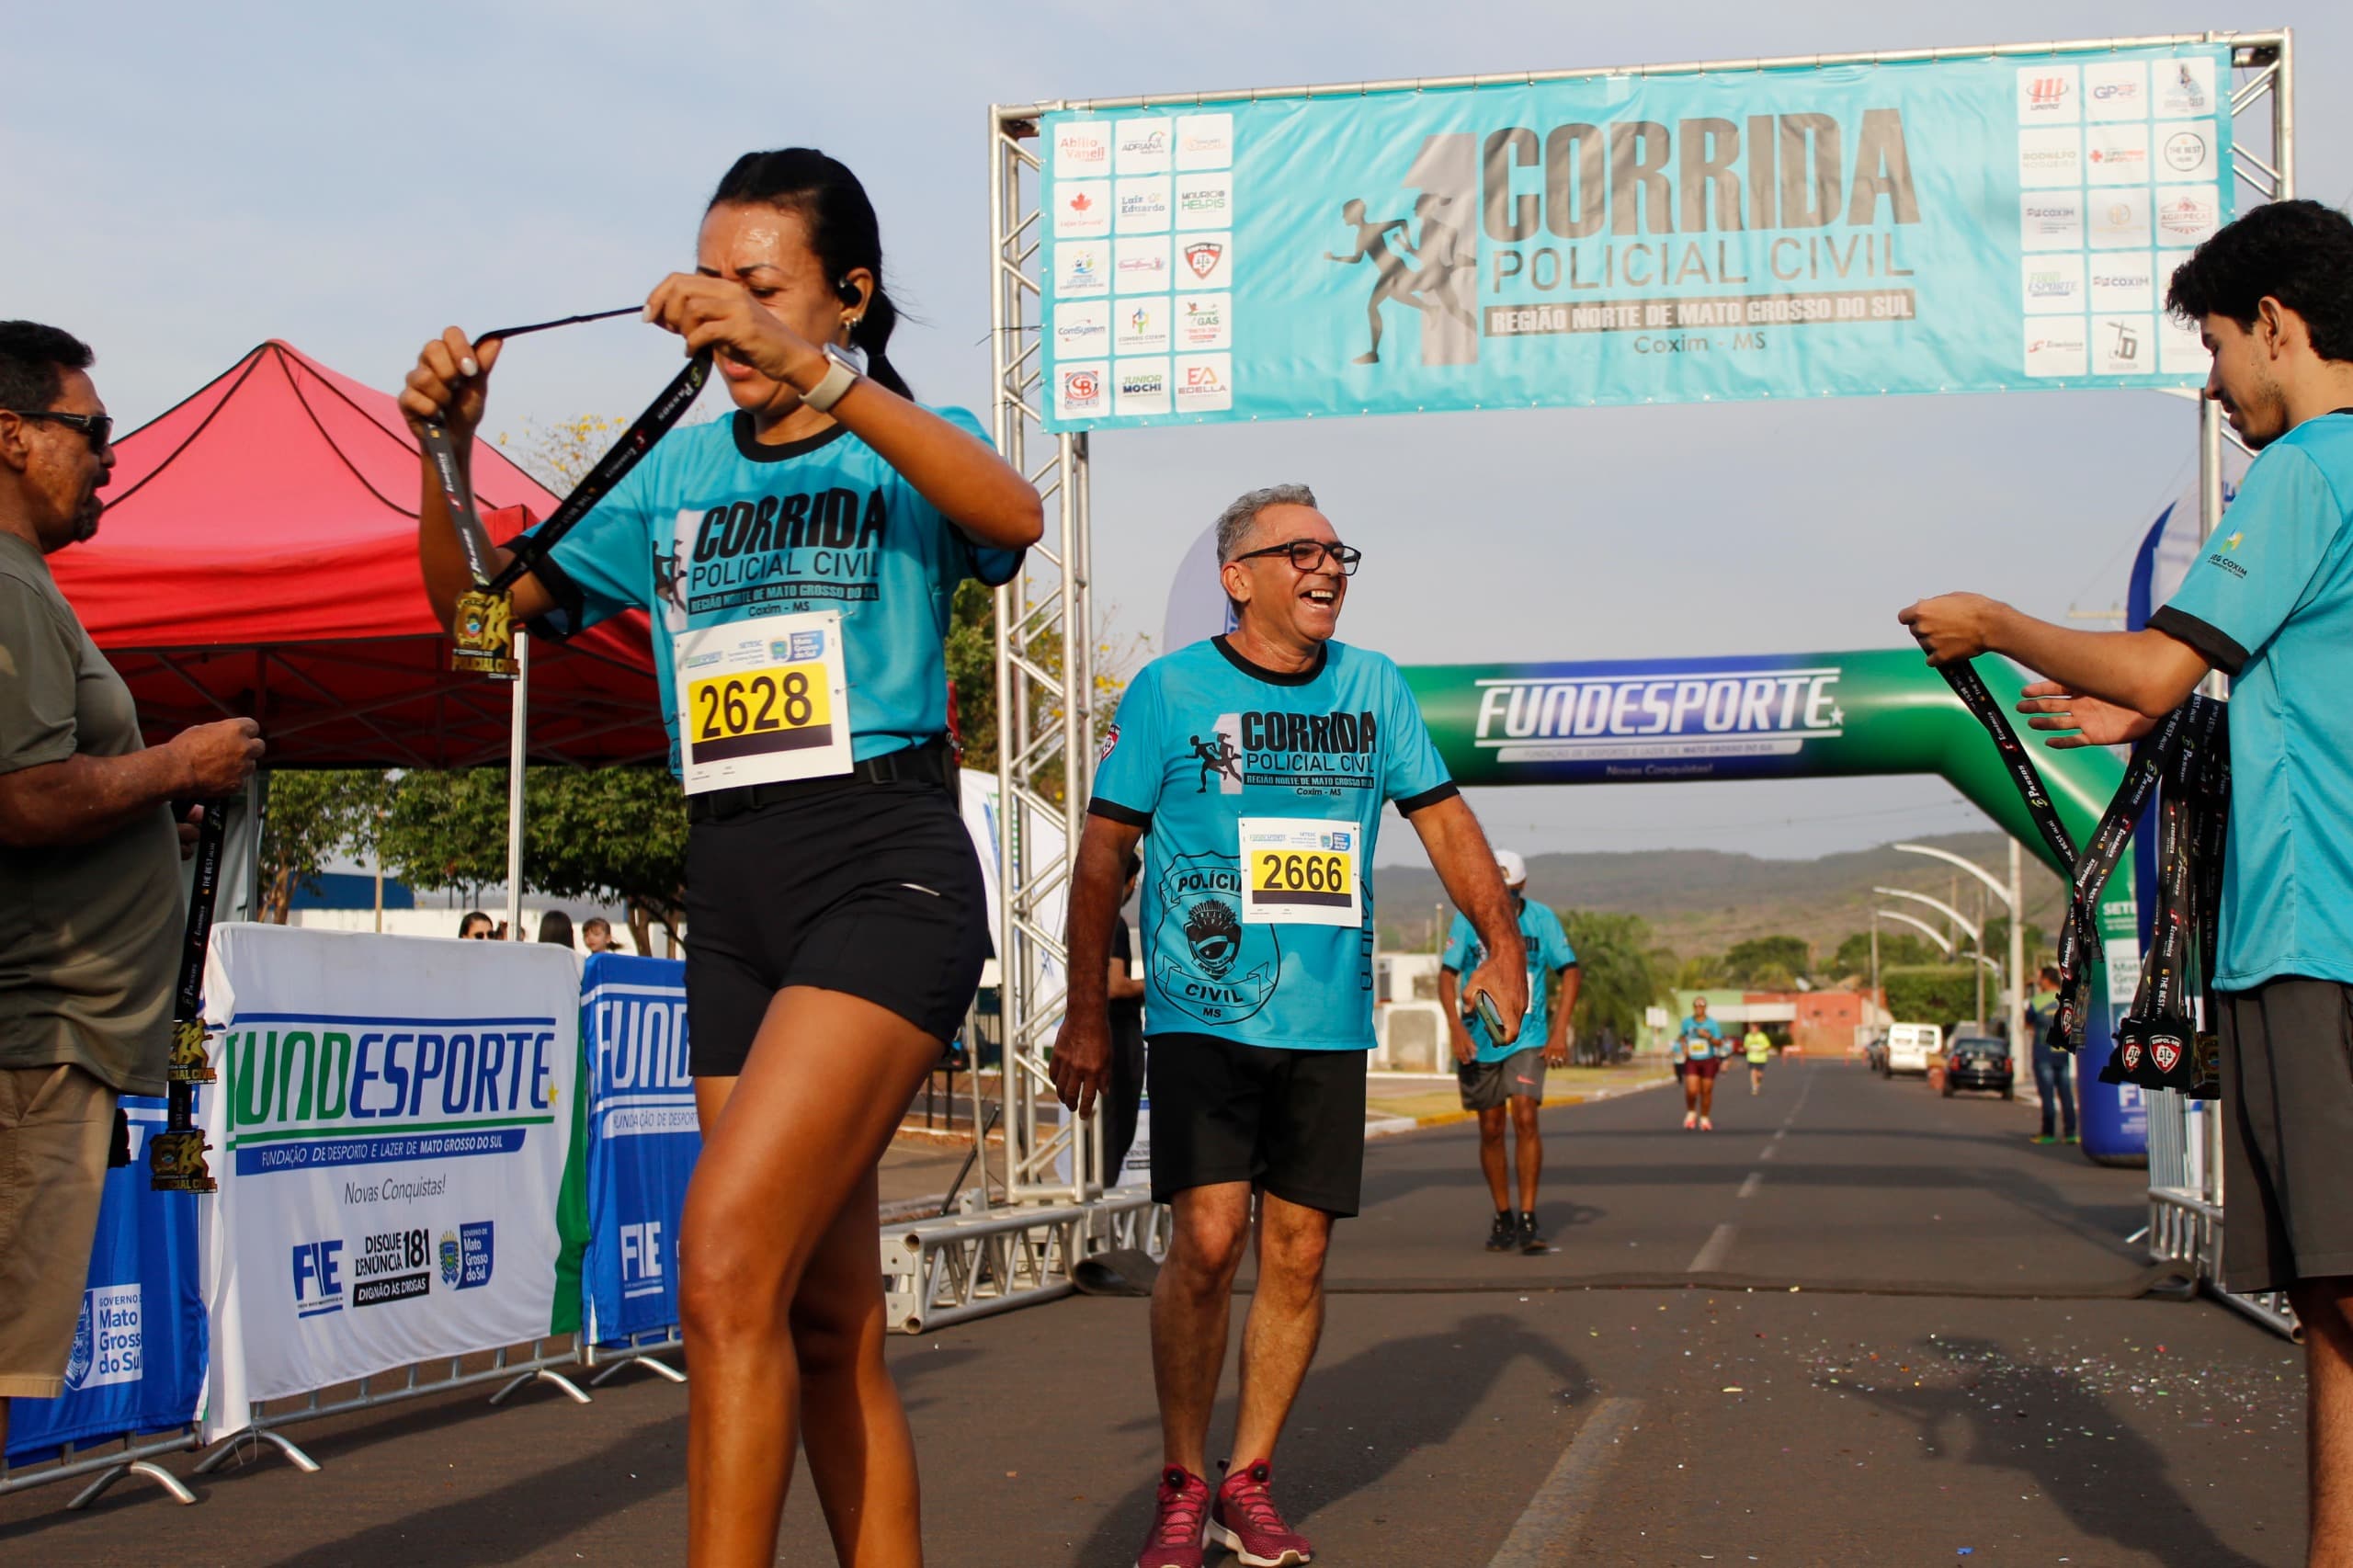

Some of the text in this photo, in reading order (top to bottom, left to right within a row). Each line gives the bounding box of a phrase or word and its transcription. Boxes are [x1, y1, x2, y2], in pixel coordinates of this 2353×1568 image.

[1483, 108, 1921, 243] CORRIDA
[1121, 203, 1165, 214] Eduardo
[1493, 233, 1915, 293] POLICIAL CIVIL
[2111, 277, 2150, 287] COXIM
[1198, 317, 1220, 325] GAS
[1491, 295, 1913, 334] REGIÃO NORTE DE MATO GROSSO DO SUL
[1058, 325, 1106, 338] ComSystem
[1633, 335, 1710, 355] Coxim
[1733, 332, 1767, 350] MS
[1122, 375, 1163, 385] JUNIOR
[1123, 383, 1162, 393] MOCHI
[692, 485, 887, 563] CORRIDA
[692, 551, 880, 591] POLICIAL CIVIL
[2222, 558, 2247, 576] COXIM
[690, 596, 722, 613] REGIÃO
[767, 585, 796, 598] MATO
[800, 584, 844, 597] GROSSO
[749, 603, 783, 617] Coxim
[792, 601, 810, 613] MS
[700, 672, 813, 739] 2628
[1475, 676, 1839, 738] FUNDESPORTE
[1241, 711, 1377, 754] CORRIDA
[1246, 754, 1336, 772] POLICIAL
[1606, 763, 1713, 777] Novas Conquistas!
[1246, 775, 1274, 785] REGIÃO
[1311, 777, 1333, 786] MATO
[1296, 788, 1341, 796] Coxim MS
[1263, 855, 1342, 892] 2666
[1185, 983, 1244, 1004] CIVIL
[2156, 976, 2170, 1008] THE BEST
[1202, 1007, 1222, 1017] MS
[657, 1112, 667, 1127] DE
[262, 1135, 503, 1167] FUNDAÇÃO DE DESPORTO E LAZER DE MATO GROSSO DO SUL
[344, 1173, 447, 1205] Novas Conquistas!
[365, 1228, 431, 1269] DISQUE 181
[463, 1238, 482, 1251] Mato
[620, 1221, 663, 1281] FIE
[355, 1253, 404, 1277] DENÚNCIA
[465, 1253, 489, 1266] Grosso
[466, 1267, 486, 1282] do Sul
[391, 1280, 401, 1295] ÀS
[401, 1278, 426, 1294] DROGAS
[99, 1294, 137, 1307] GOVERNO
[99, 1309, 138, 1329] Mato
[99, 1349, 142, 1373] do Sul
